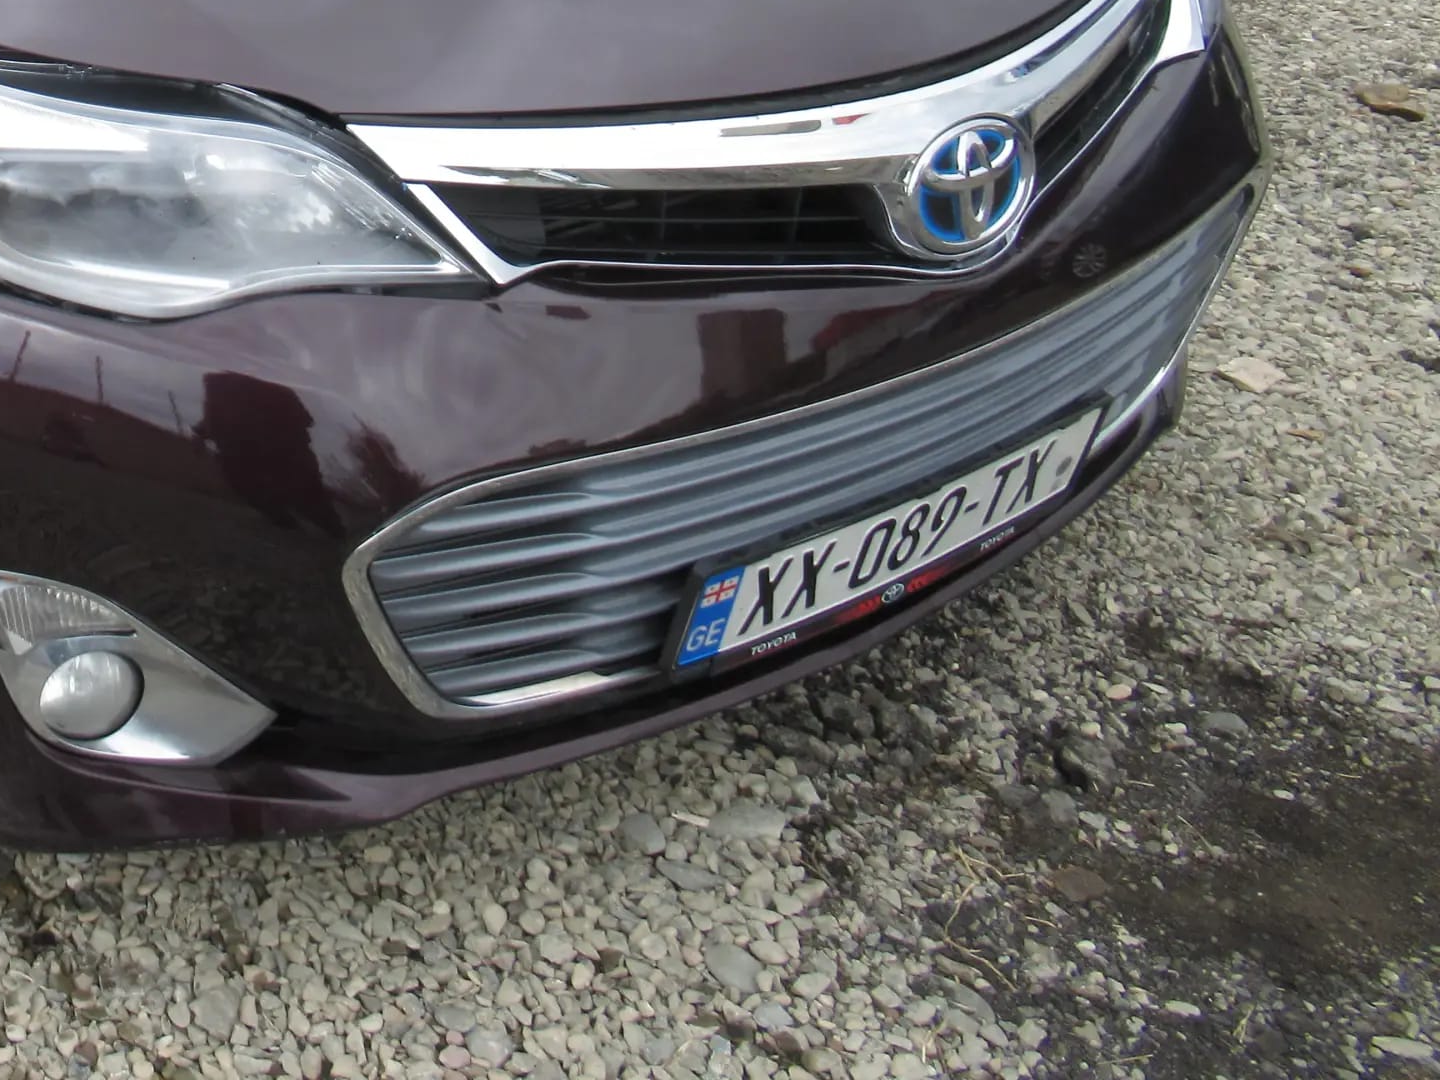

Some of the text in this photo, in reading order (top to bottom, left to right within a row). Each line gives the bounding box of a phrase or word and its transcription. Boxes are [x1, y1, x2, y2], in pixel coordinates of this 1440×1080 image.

[737, 438, 1058, 637] XX-089-TX
[980, 525, 1015, 552] TOYOTA
[686, 617, 726, 652] GE
[751, 631, 797, 656] TOYOTA
